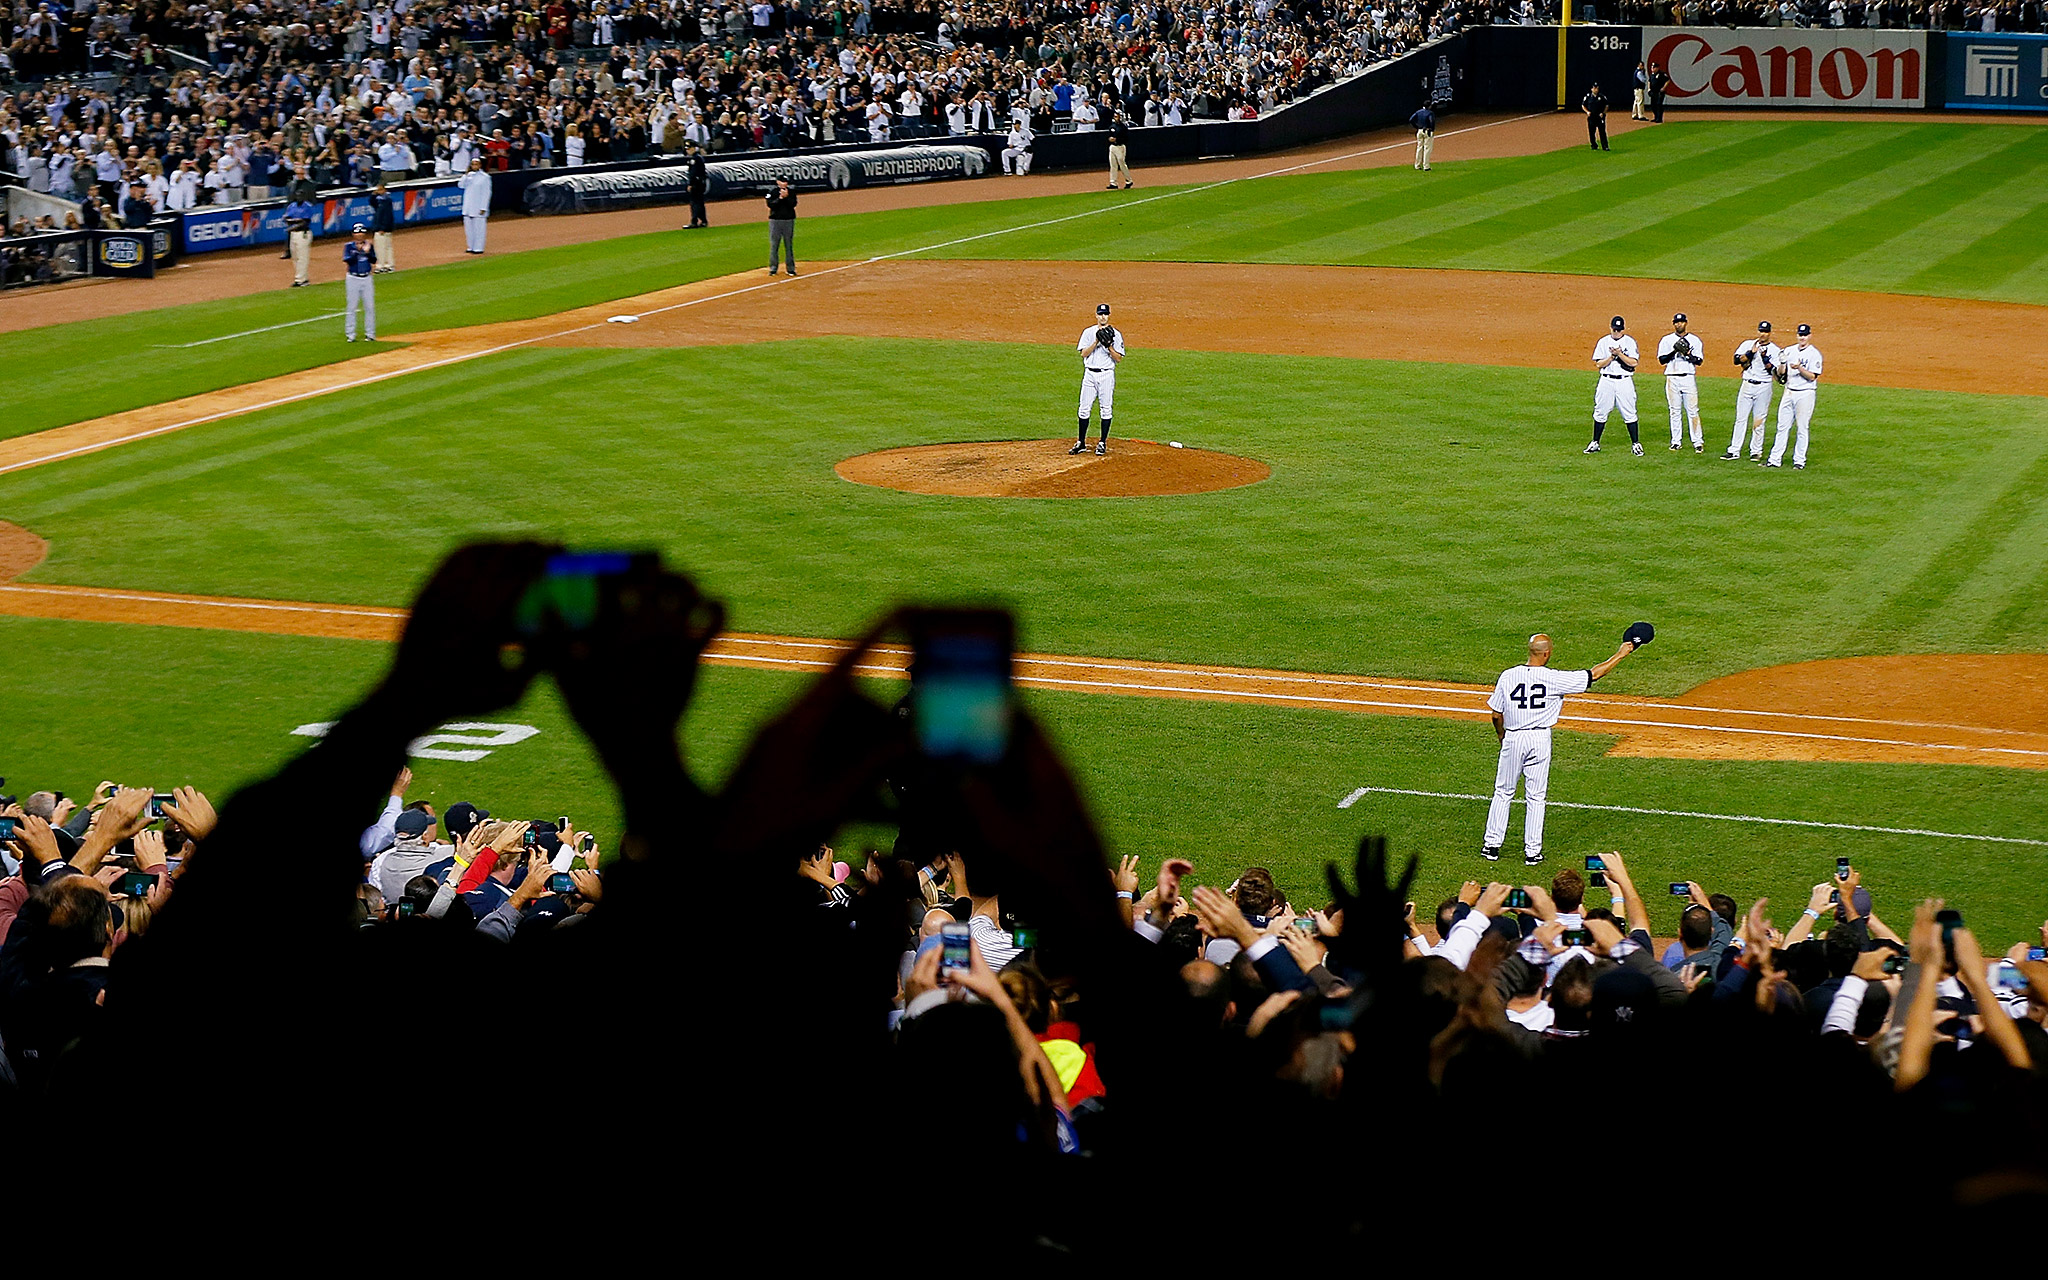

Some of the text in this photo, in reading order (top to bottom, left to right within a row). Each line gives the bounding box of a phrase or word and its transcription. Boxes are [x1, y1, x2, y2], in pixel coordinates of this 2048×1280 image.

[1647, 33, 1921, 100] Canon
[862, 156, 961, 176] WEATHERPROOF
[189, 220, 242, 242] GEICO
[1510, 683, 1546, 709] 42
